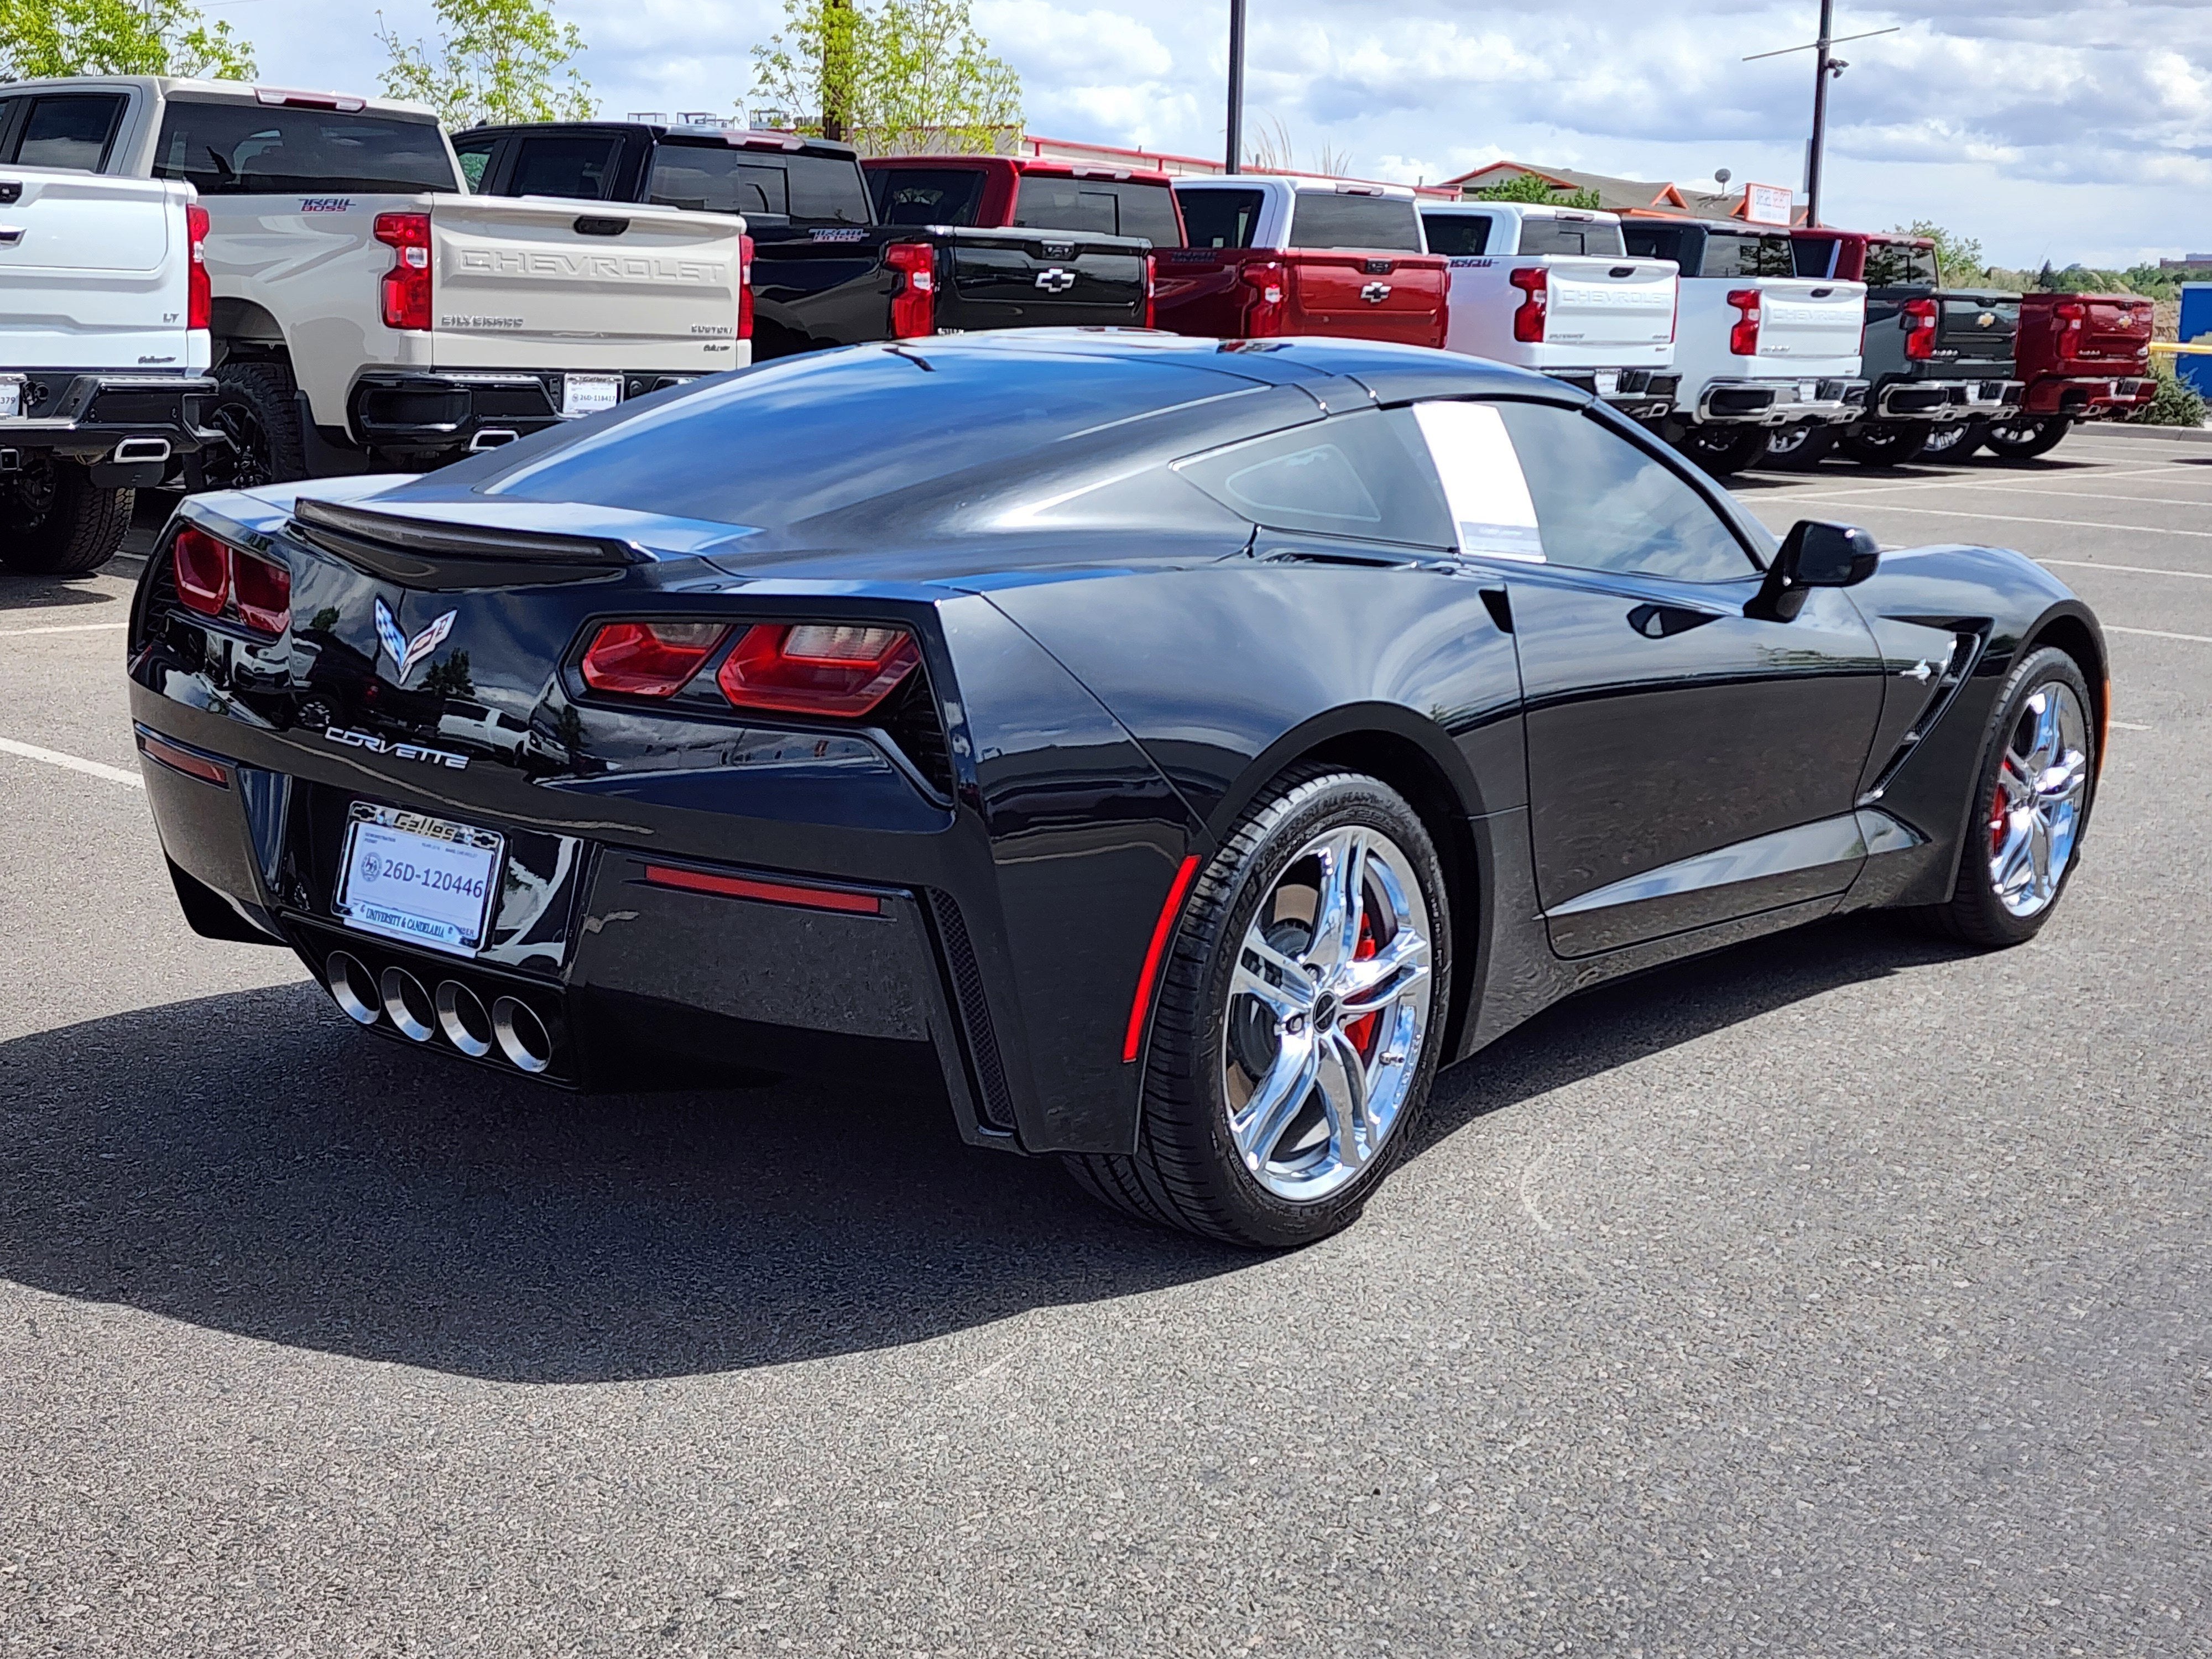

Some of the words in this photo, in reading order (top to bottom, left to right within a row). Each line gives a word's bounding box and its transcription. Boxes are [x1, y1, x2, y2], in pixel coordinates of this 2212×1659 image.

[460, 249, 726, 283] CHEVROLET
[163, 313, 179, 323] LT
[325, 726, 469, 769] CORVETTE
[393, 812, 455, 840] Galles
[383, 859, 484, 898] 26D-120446
[366, 907, 401, 927] UNIVERSITY
[401, 916, 406, 928] &
[406, 918, 445, 938] CANDELARIA
